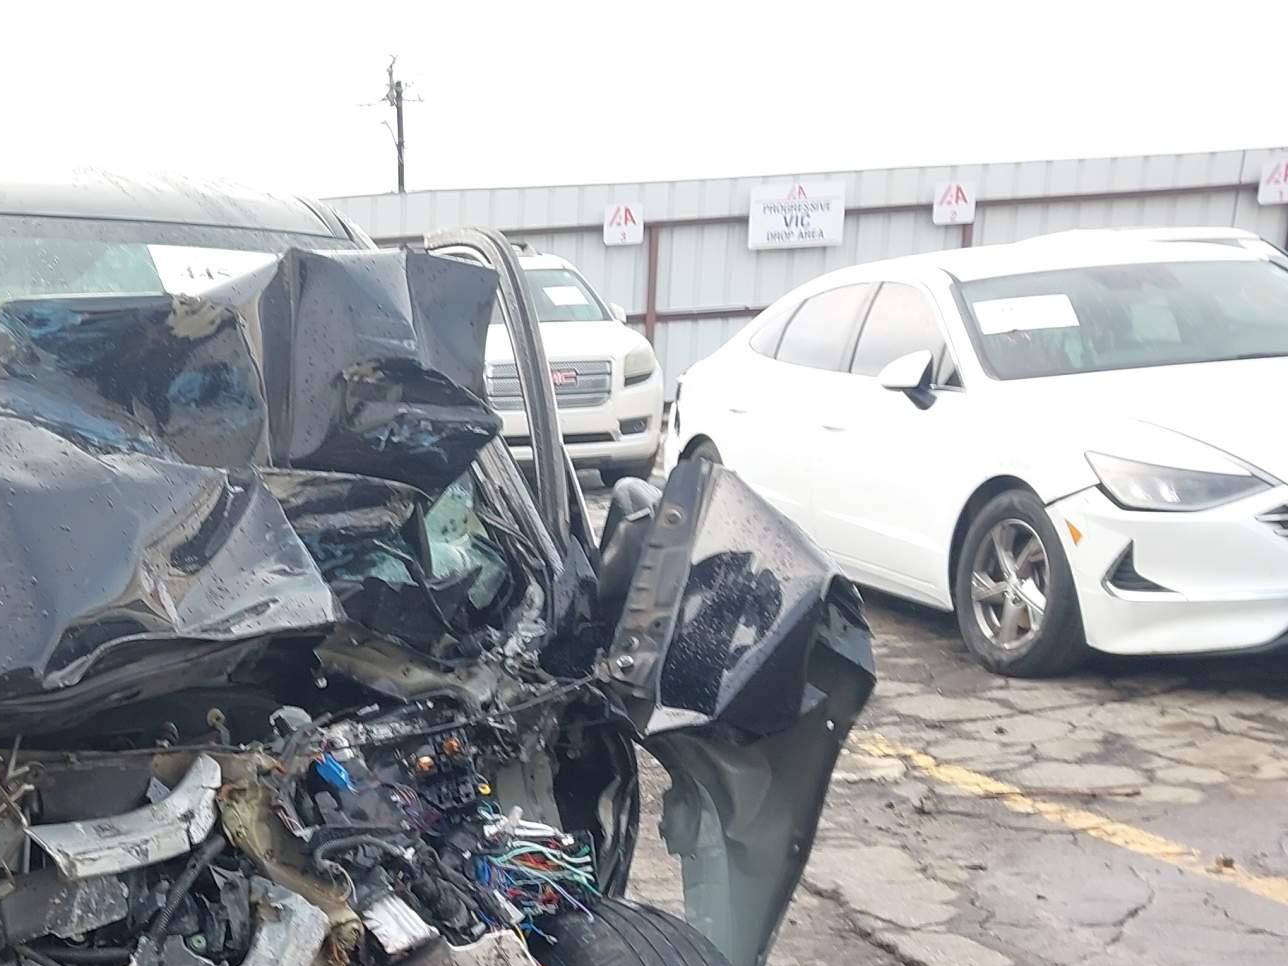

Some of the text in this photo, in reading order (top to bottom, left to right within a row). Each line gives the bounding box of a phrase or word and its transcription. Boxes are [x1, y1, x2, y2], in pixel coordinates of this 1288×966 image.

[761, 200, 831, 215] PROGRESSIVE
[782, 212, 812, 229] VIC
[766, 228, 825, 242] DROP AREA
